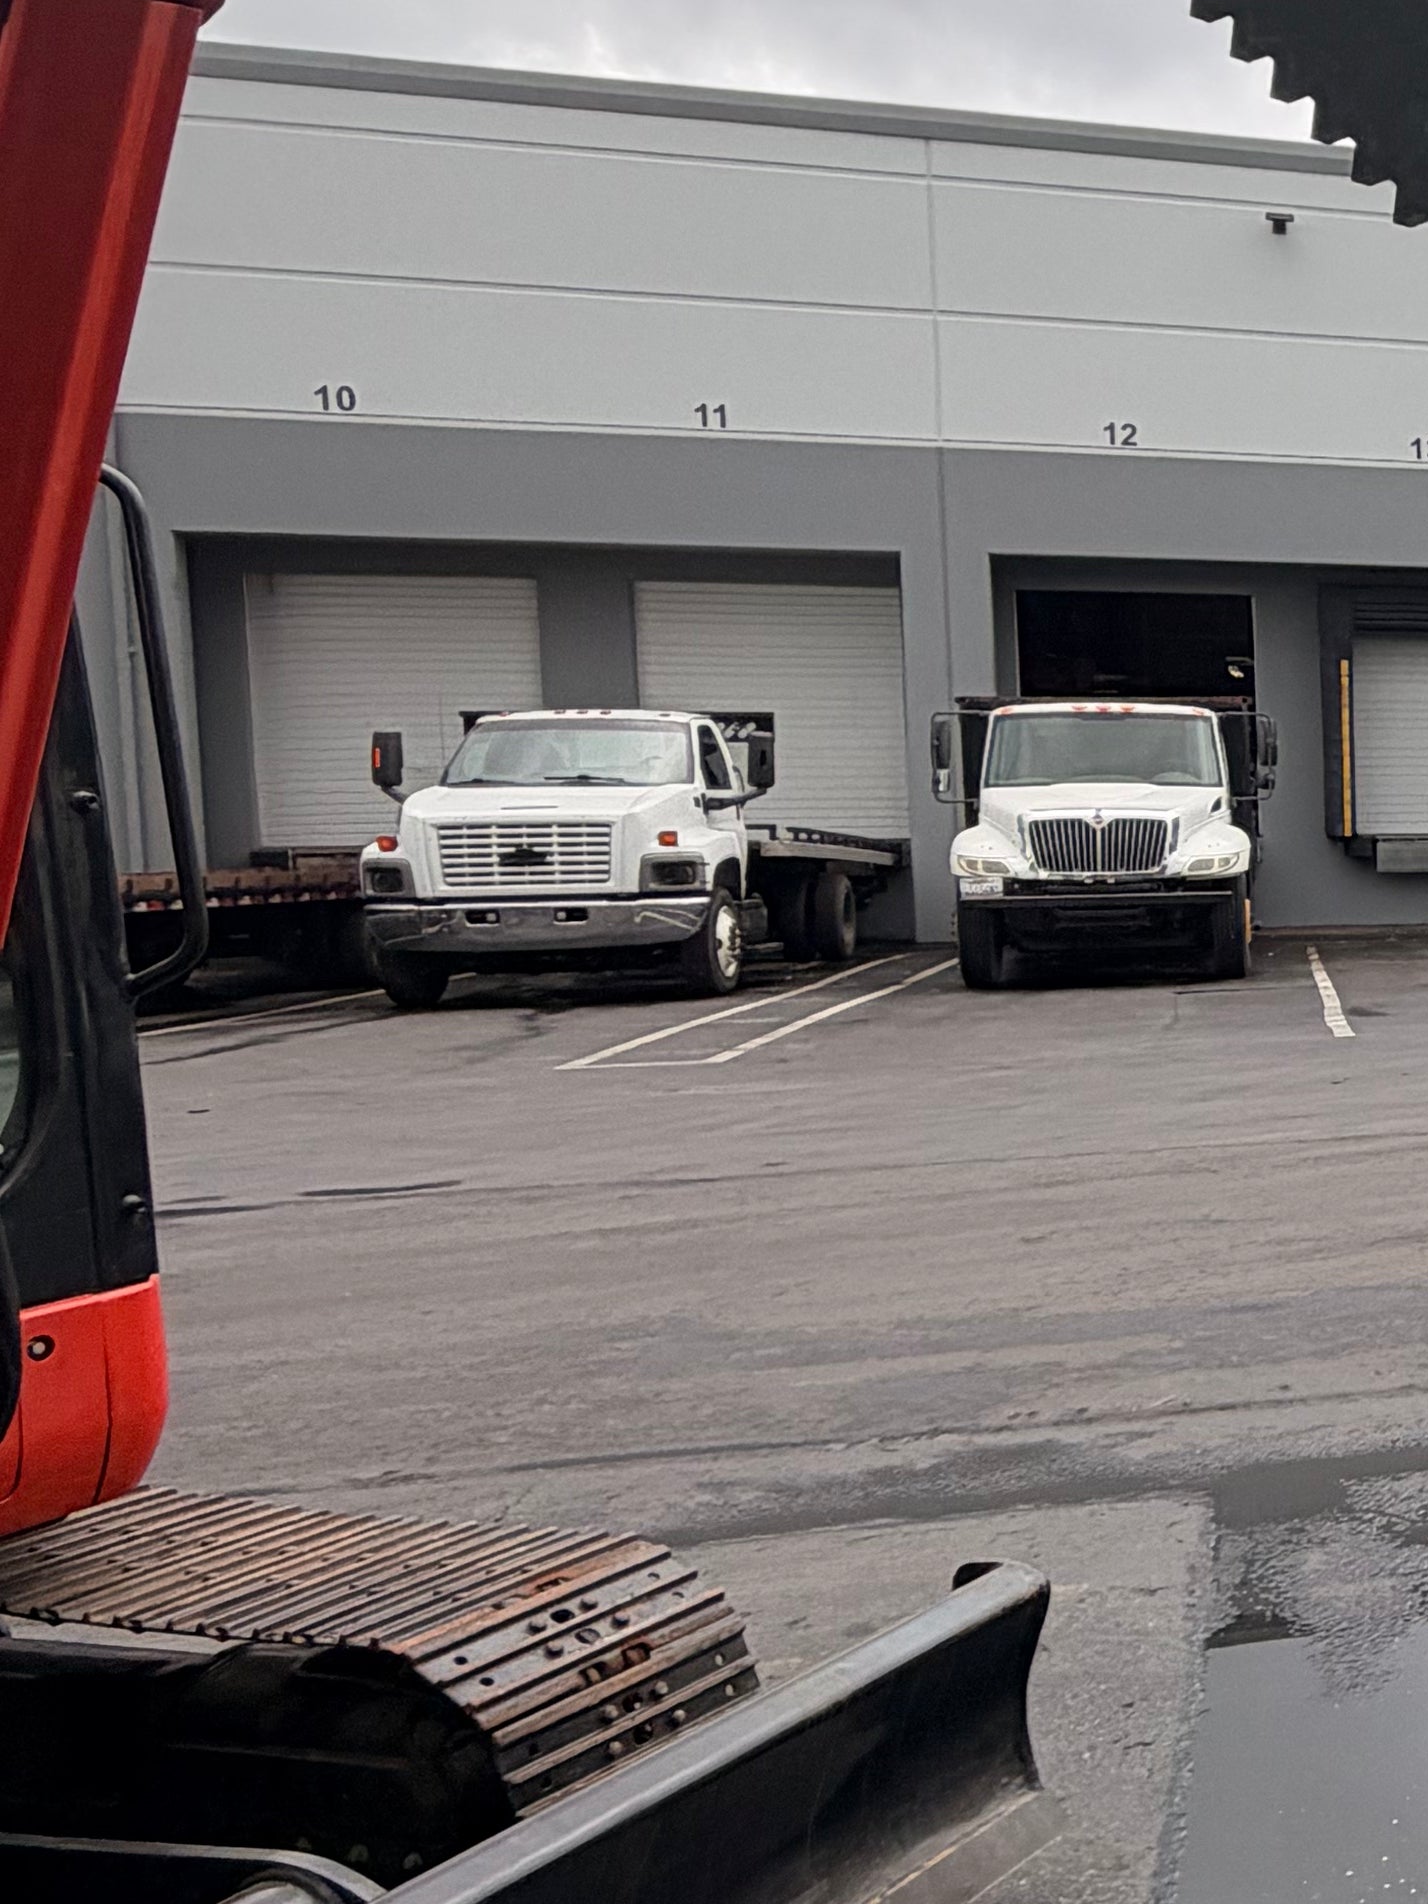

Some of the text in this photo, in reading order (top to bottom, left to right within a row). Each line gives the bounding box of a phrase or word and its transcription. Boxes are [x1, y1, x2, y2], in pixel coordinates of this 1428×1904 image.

[313, 384, 357, 412] 10
[694, 402, 727, 429] 11
[1103, 421, 1138, 447] 12
